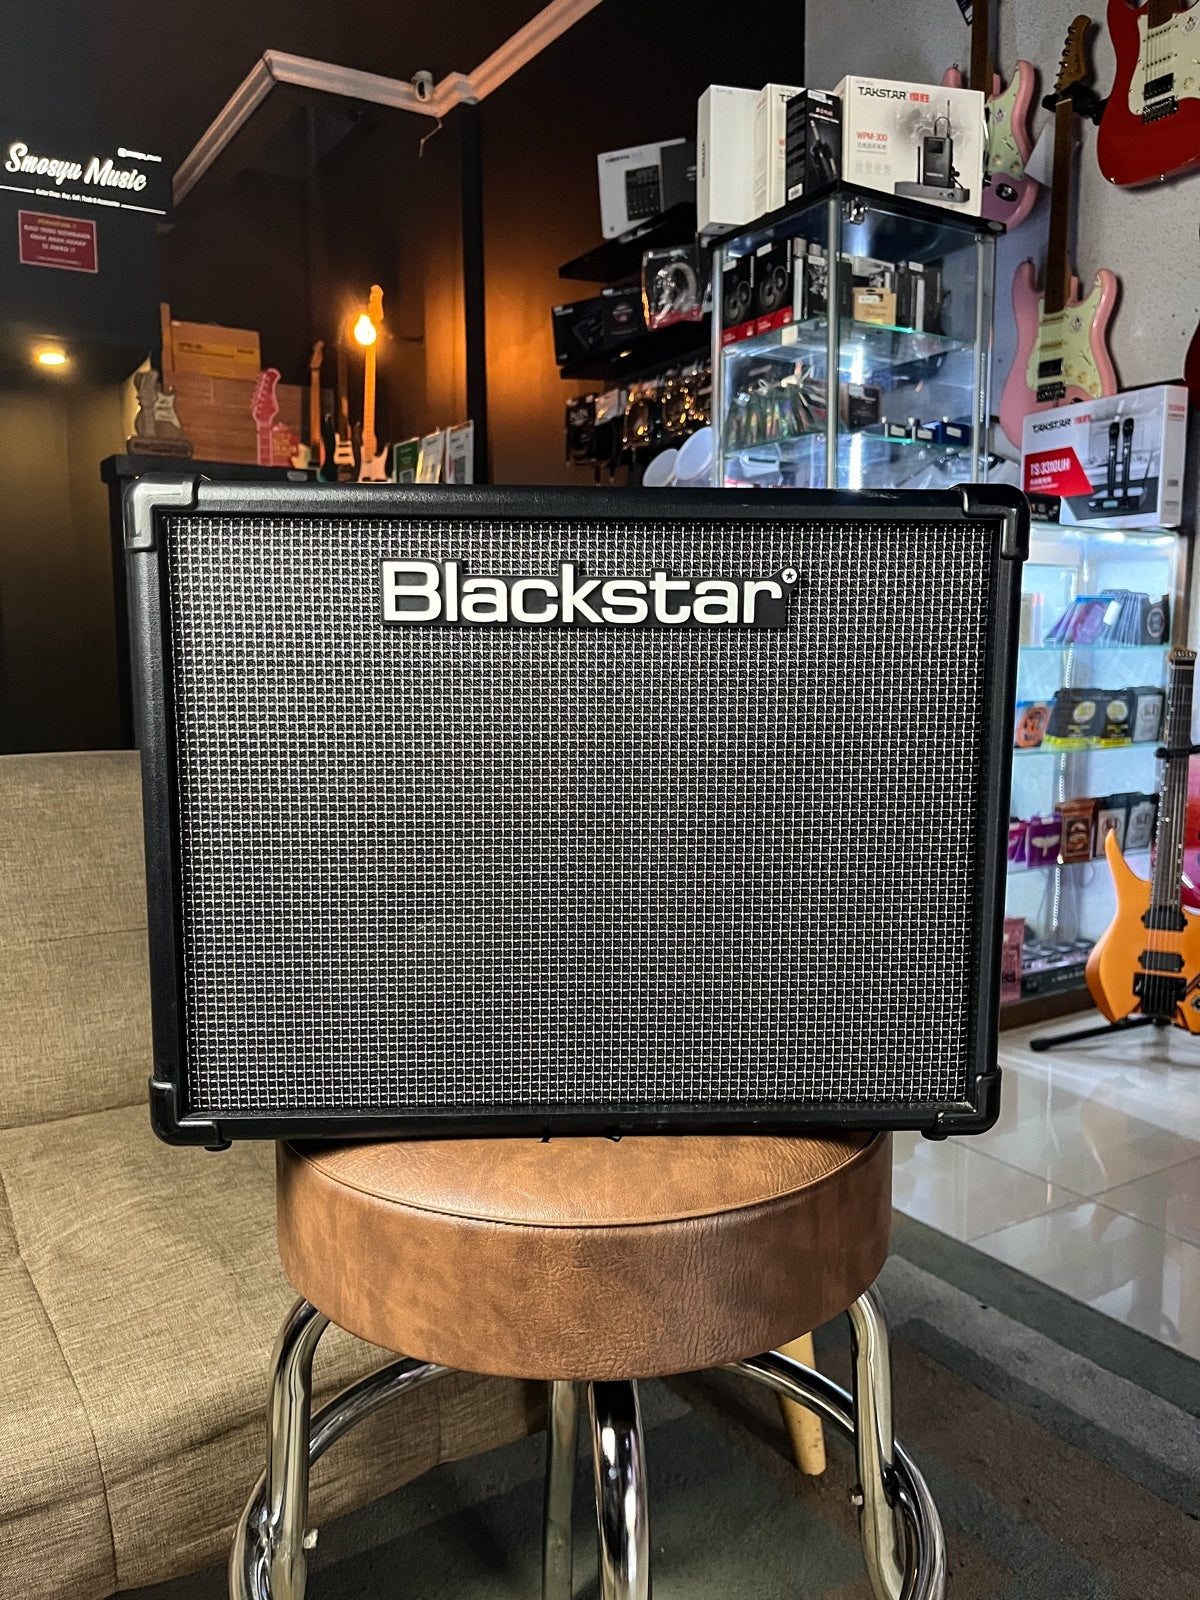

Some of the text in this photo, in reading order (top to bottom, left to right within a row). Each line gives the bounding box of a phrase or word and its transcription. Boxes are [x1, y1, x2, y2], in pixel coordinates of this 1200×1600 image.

[858, 86, 907, 100] TAKSTAR
[5, 142, 83, 185] Smosyu
[84, 156, 147, 191] Music
[382, 561, 783, 624] Blackstar
